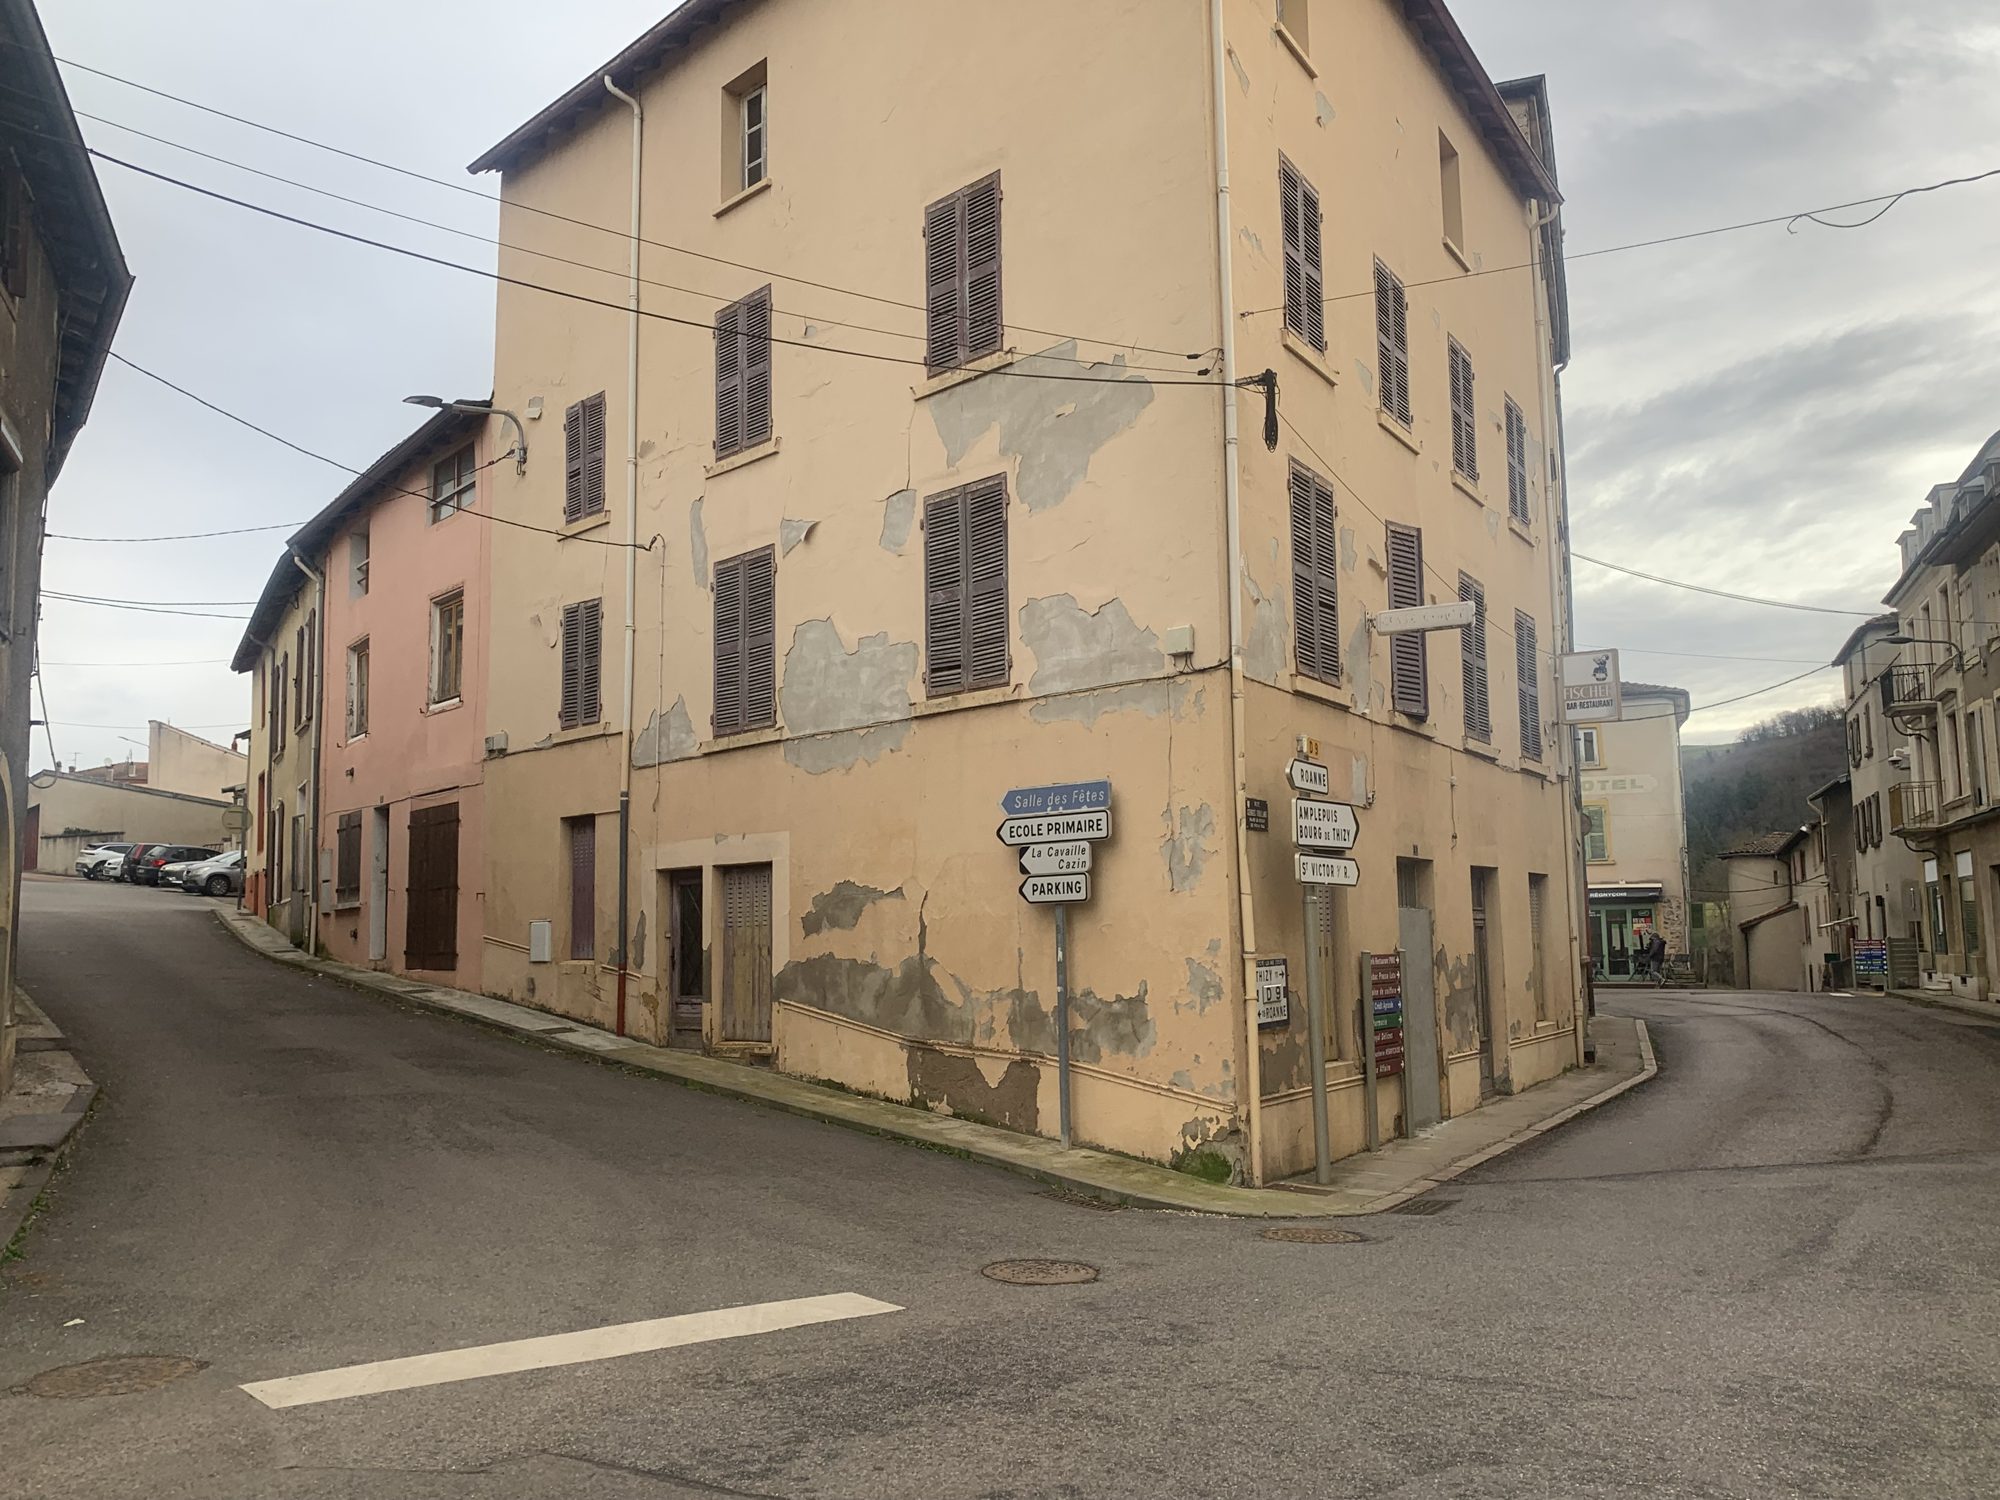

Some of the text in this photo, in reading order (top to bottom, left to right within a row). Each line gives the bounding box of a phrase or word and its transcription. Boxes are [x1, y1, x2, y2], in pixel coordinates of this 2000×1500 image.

[1300, 768, 1326, 787] ROANNE
[1582, 779, 1644, 792] OTEL
[1014, 789, 1105, 809] Salle des Fêtes
[1299, 806, 1338, 823] AMPLEPUIS
[1009, 819, 1102, 838] ECOLE PRIMAIRE
[1299, 824, 1351, 843] BOURG DE THIZY
[1031, 844, 1086, 859] La Cavaille
[1058, 858, 1087, 870] Cazin
[1311, 862, 1335, 878] VICTOR
[1031, 880, 1082, 896] PARKING
[1256, 969, 1273, 983] THIZY
[1266, 986, 1272, 1001] D
[1275, 985, 1281, 1000] 9
[1265, 1004, 1287, 1019] ROANNE
